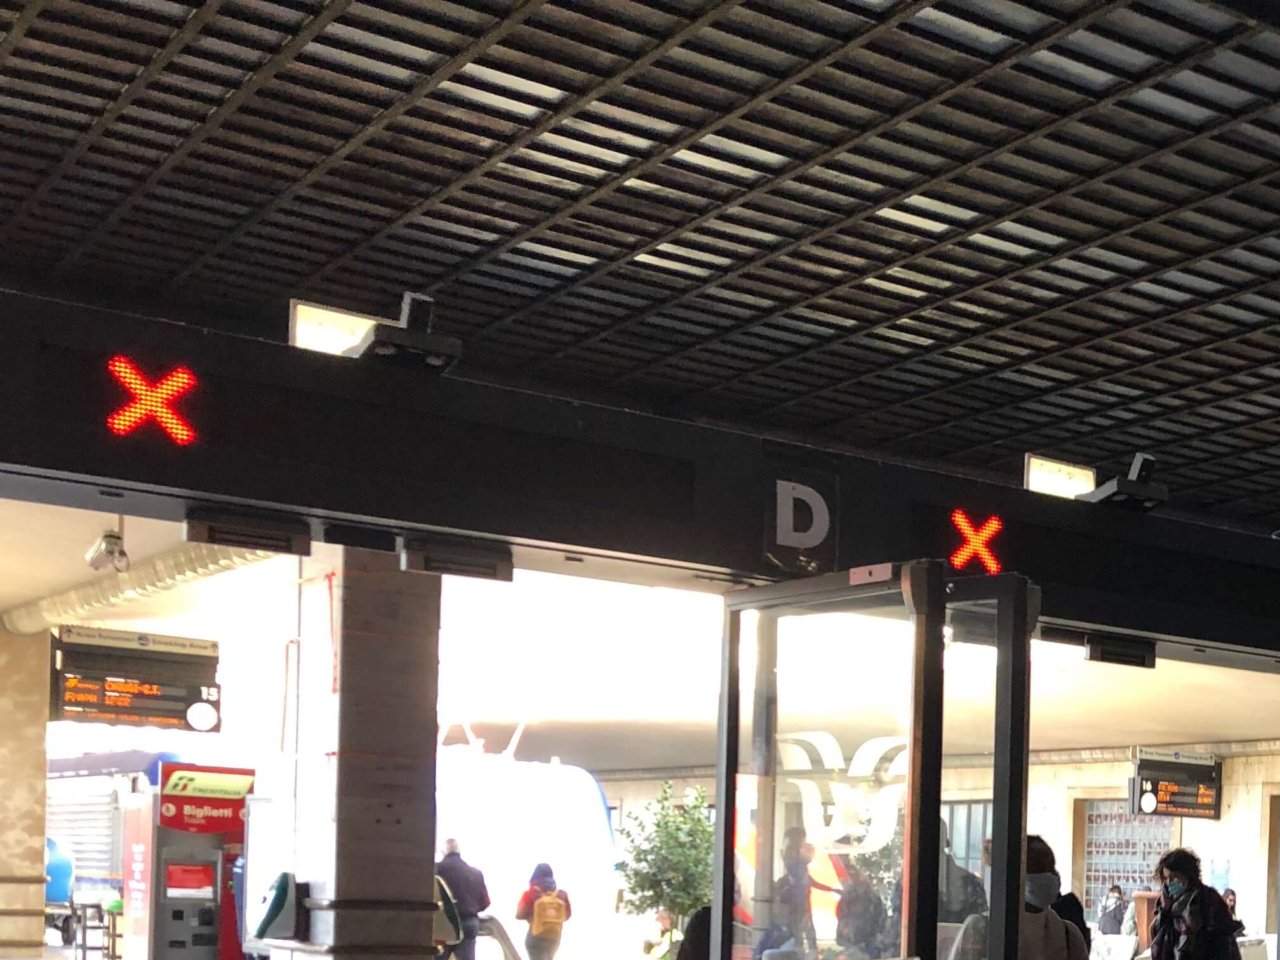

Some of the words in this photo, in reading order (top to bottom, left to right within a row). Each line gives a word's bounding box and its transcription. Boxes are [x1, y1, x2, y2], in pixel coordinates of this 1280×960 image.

[775, 480, 830, 548] D
[200, 686, 219, 701] 15
[1142, 780, 1152, 791] 16
[183, 804, 232, 819] Biglietti
